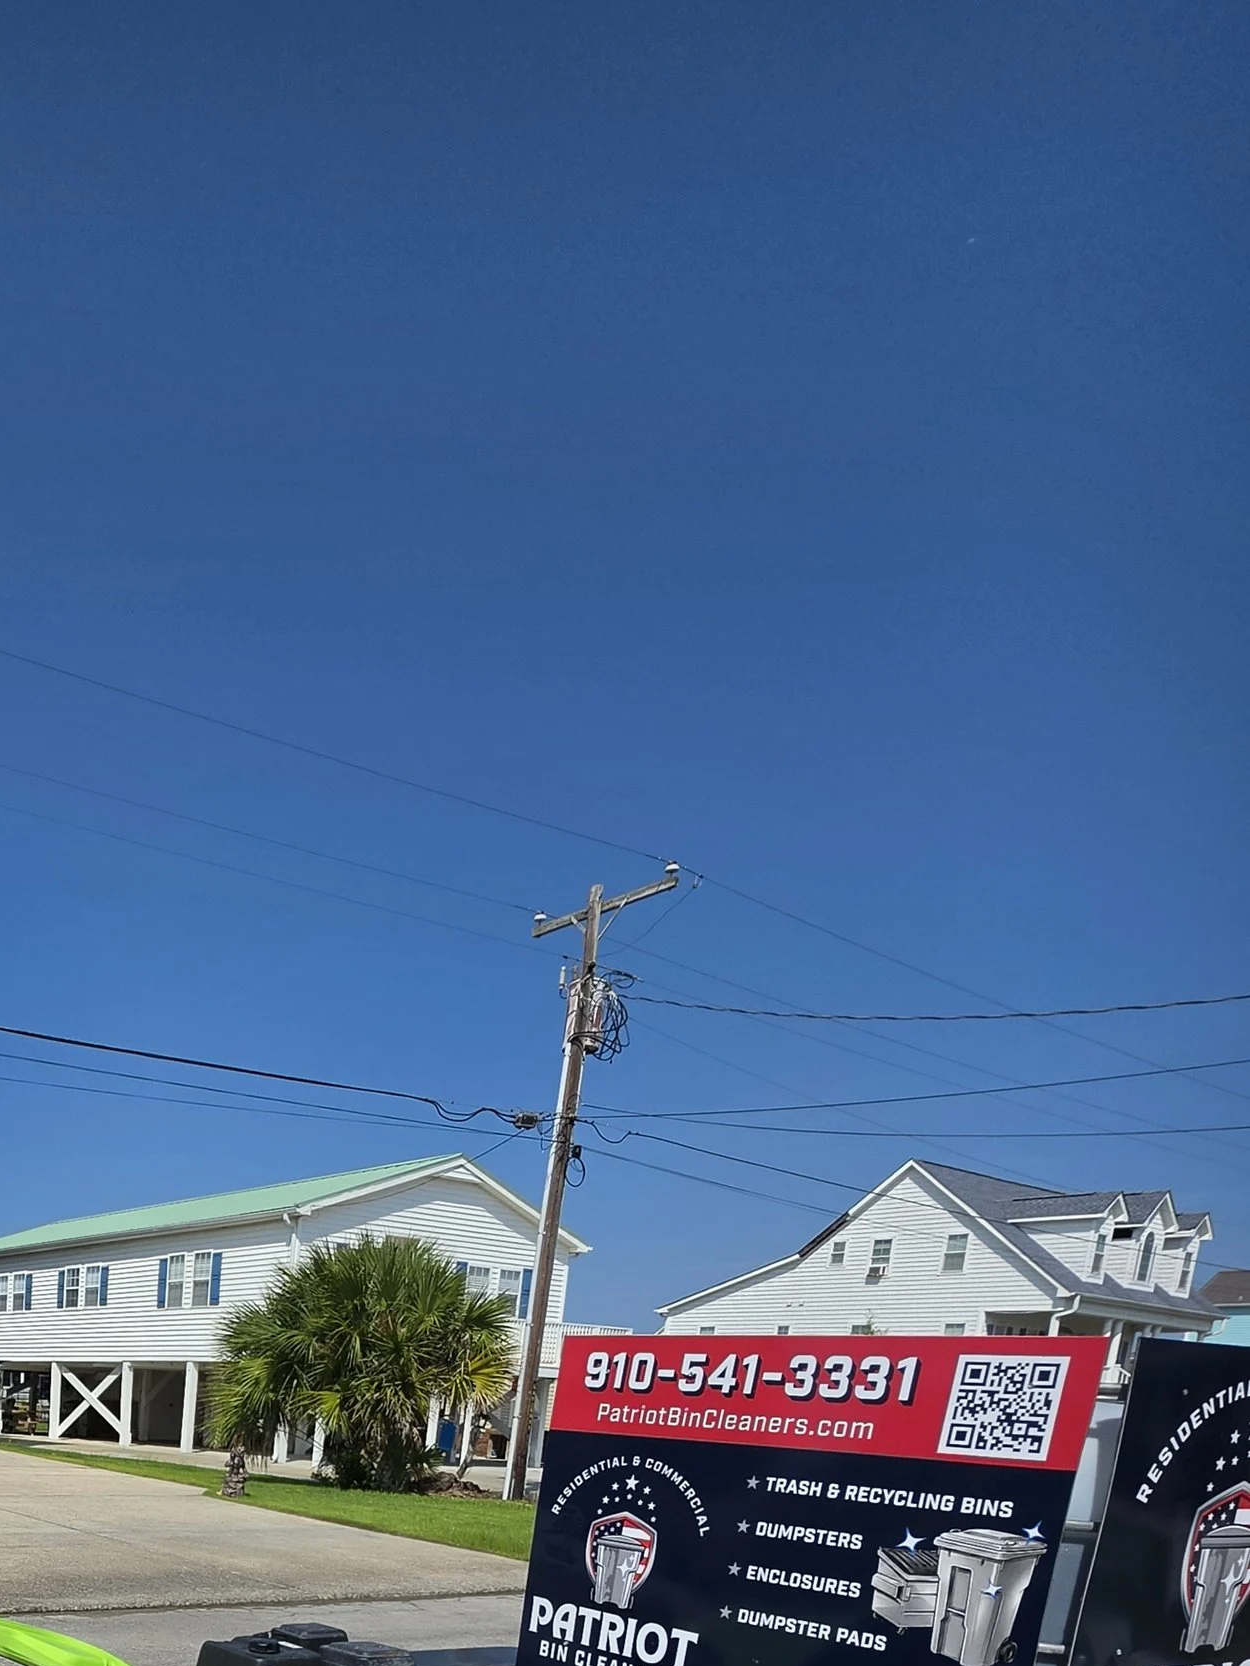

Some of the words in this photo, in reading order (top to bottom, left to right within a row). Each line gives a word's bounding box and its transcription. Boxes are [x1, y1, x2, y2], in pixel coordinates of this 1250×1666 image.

[584, 1351, 922, 1404] 910-541-3331
[596, 1403, 875, 1441] PatriotBinCleaners.com
[551, 1455, 628, 1516] RESIDENTIAL
[632, 1455, 642, 1467] &
[644, 1458, 711, 1538] COMMERCIAL
[765, 1476, 824, 1498] TRASH
[826, 1482, 841, 1500] &
[844, 1485, 956, 1513] RECYCLING
[960, 1496, 1015, 1519] BINS
[755, 1520, 864, 1551] DUMPSTERS
[745, 1564, 862, 1599] ENCLOSURES
[736, 1607, 831, 1642] DUMPSTER
[835, 1626, 888, 1652] PADS
[539, 1639, 569, 1663] BIN
